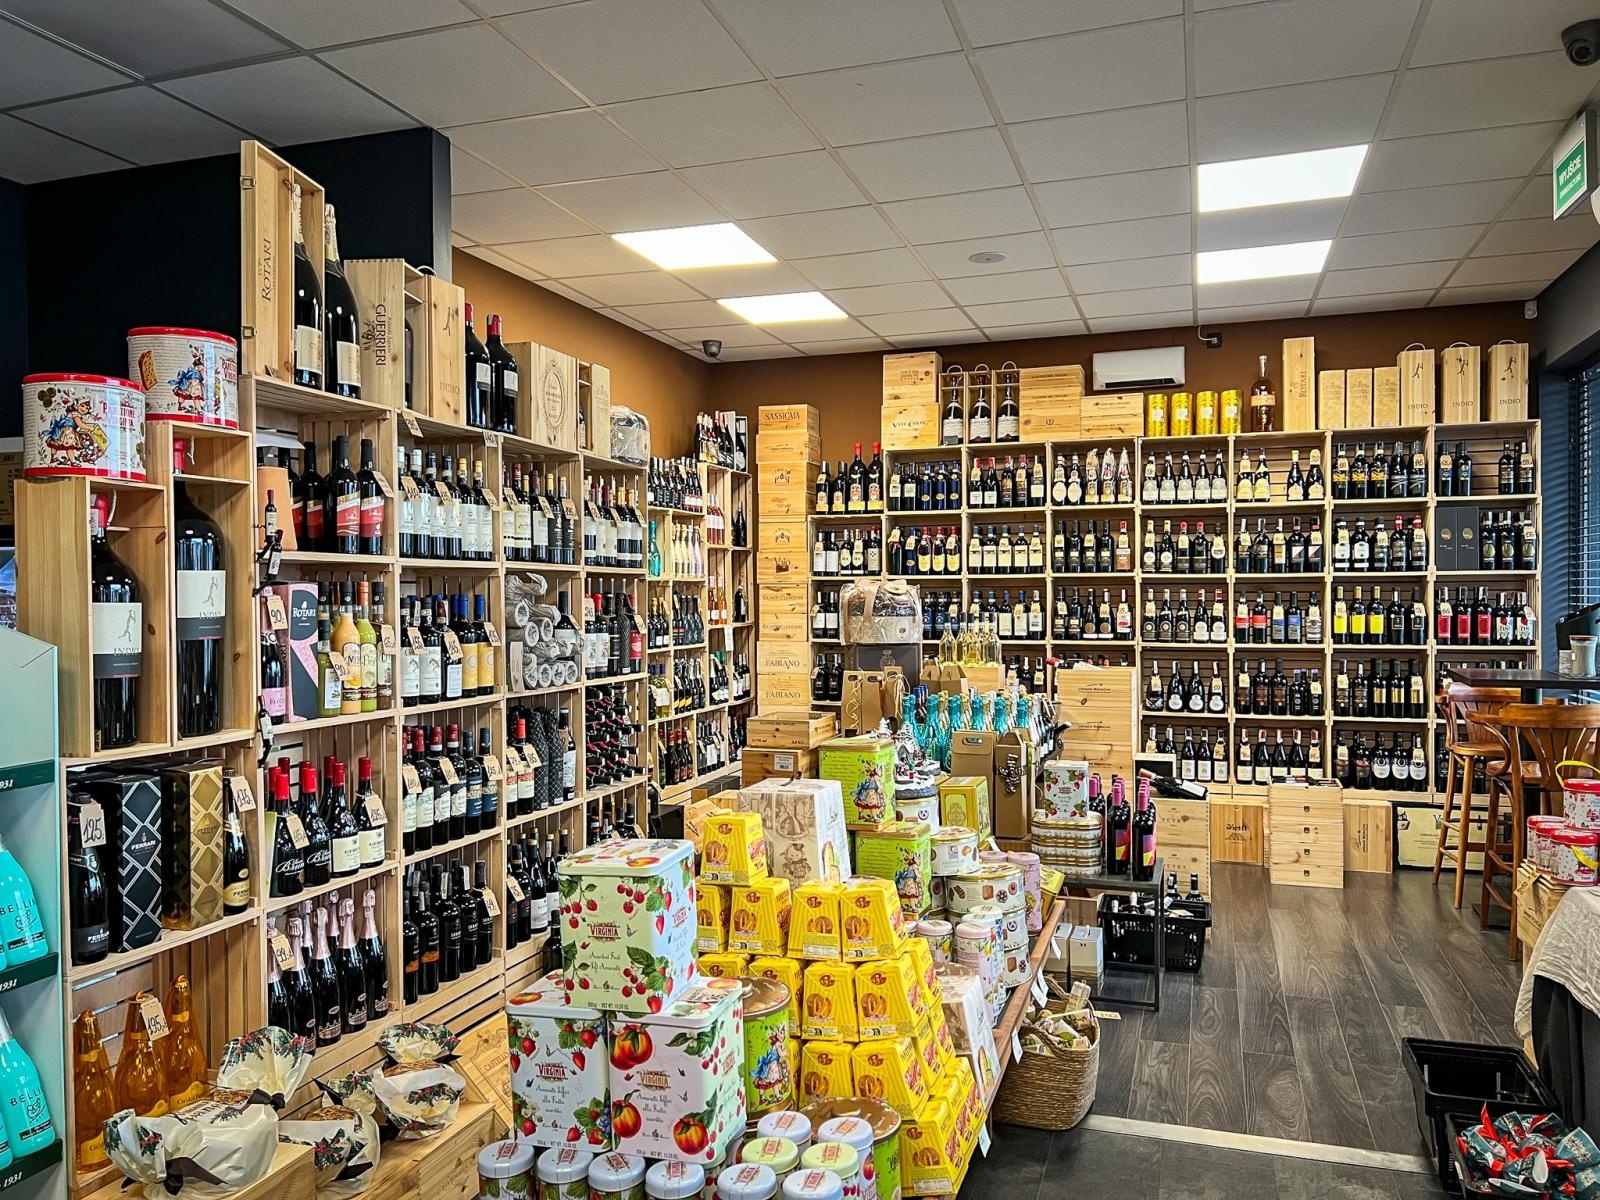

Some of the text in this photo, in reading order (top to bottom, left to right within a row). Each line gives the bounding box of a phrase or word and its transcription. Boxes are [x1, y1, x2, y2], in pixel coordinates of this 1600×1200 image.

[1559, 154, 1582, 186] WYJŚCIE
[262, 238, 271, 302] ROTARI
[375, 303, 387, 367] GUERRIERI
[1407, 402, 1429, 410] INDIO
[1499, 398, 1521, 406] INDIO
[765, 411, 801, 421] SASSICAIA
[292, 607, 316, 618] ROTARI
[113, 647, 139, 656] INDIO
[765, 659, 800, 667] FABIANO
[766, 691, 801, 699] FABIANO
[131, 839, 156, 851] FERRARI
[589, 925, 619, 938] VIRGINIA
[538, 1063, 566, 1078] VIRGINIA
[640, 1074, 669, 1088] VIRGINIA
